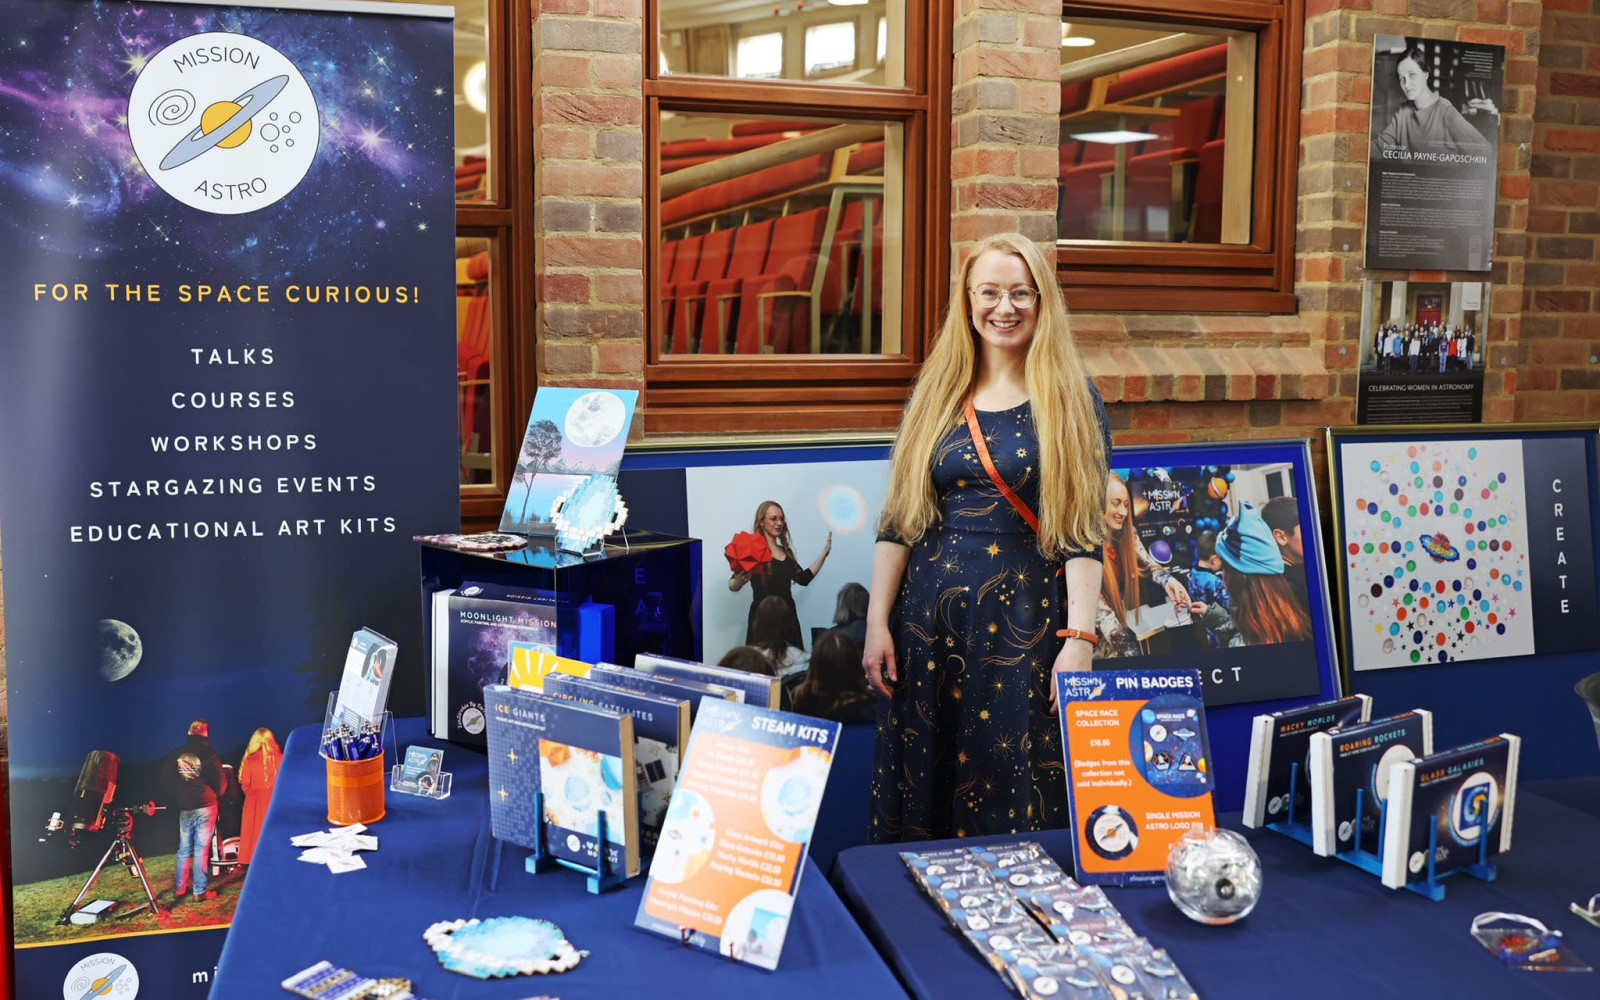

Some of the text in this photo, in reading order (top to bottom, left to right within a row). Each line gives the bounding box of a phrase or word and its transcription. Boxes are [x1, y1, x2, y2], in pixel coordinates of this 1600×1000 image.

[173, 46, 260, 73] MISSION
[1382, 150, 1487, 164] CECILIA PAYNE-GAPOSCHKIN
[194, 177, 267, 201] ASTRO
[34, 283, 420, 304] FOR THE SPACE CURIOUS!
[191, 348, 274, 365] TALKS
[1368, 384, 1406, 392] CELEBRATING
[1407, 384, 1430, 392] WOMEN
[171, 391, 295, 409] COURSES
[151, 434, 317, 452] WORKSHOPS
[90, 475, 376, 498] STARGAZING EVENTS
[70, 517, 396, 543] EDUCATIONAL ART KITS
[1552, 479, 1570, 614] CREATE
[460, 612, 557, 628] MOONLIGHT MISSION
[1116, 676, 1194, 689] PIN BADGES
[494, 704, 546, 722] ICE GIANTS
[1076, 709, 1118, 718] SPACE RACE
[752, 716, 829, 744] STEAM KITS
[1076, 719, 1120, 727] COLLECTION
[1280, 722, 1305, 732] WACKY
[1307, 714, 1336, 726] WORLDS
[1340, 737, 1372, 752] ROARING
[1374, 728, 1407, 744] ROCKETS
[1420, 768, 1446, 782] GLASS
[1446, 758, 1485, 775] GALAXIES
[1171, 810, 1200, 819] MISSION
[1145, 822, 1170, 830] ASTRO
[1170, 822, 1190, 830] LOGO
[80, 957, 116, 971] MISSION
